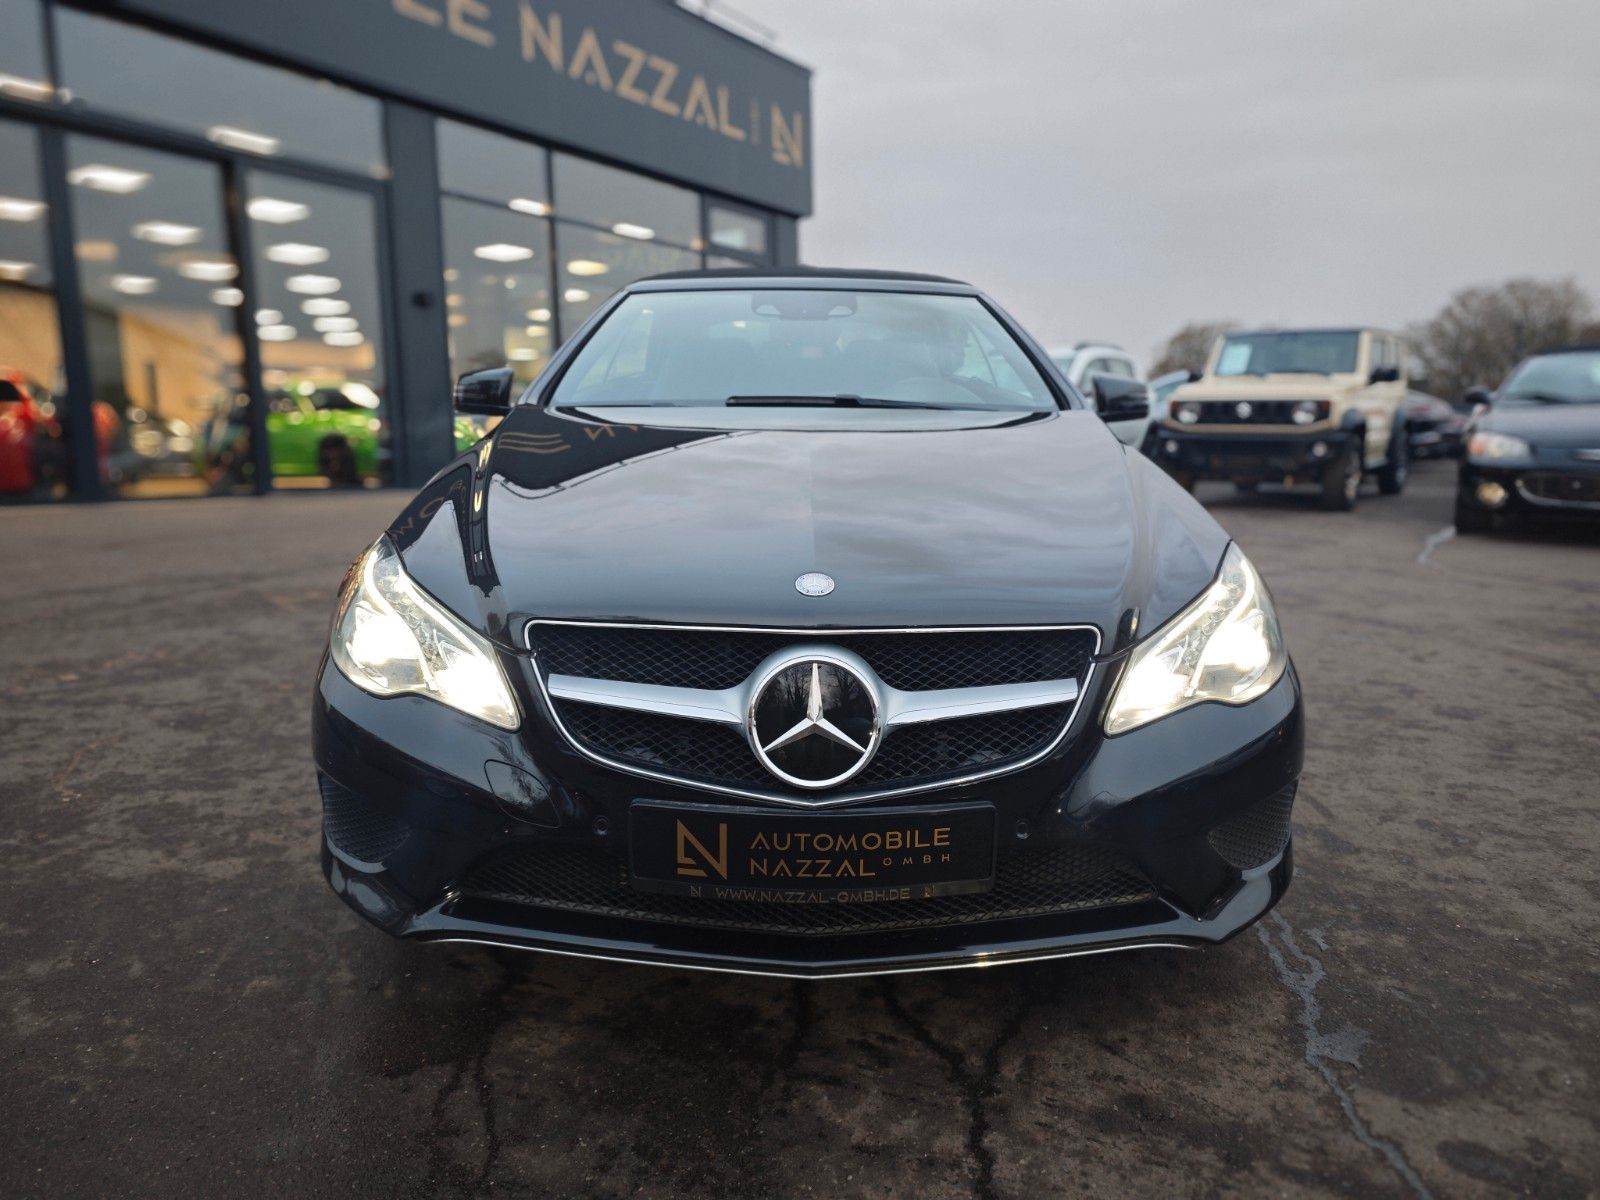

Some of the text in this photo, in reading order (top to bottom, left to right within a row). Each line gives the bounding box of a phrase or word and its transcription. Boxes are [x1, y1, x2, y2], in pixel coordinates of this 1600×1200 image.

[518, 1, 746, 141] NAZZAL
[749, 827, 951, 851] AUTOMOBILE
[750, 858, 876, 877] NAZZAL
